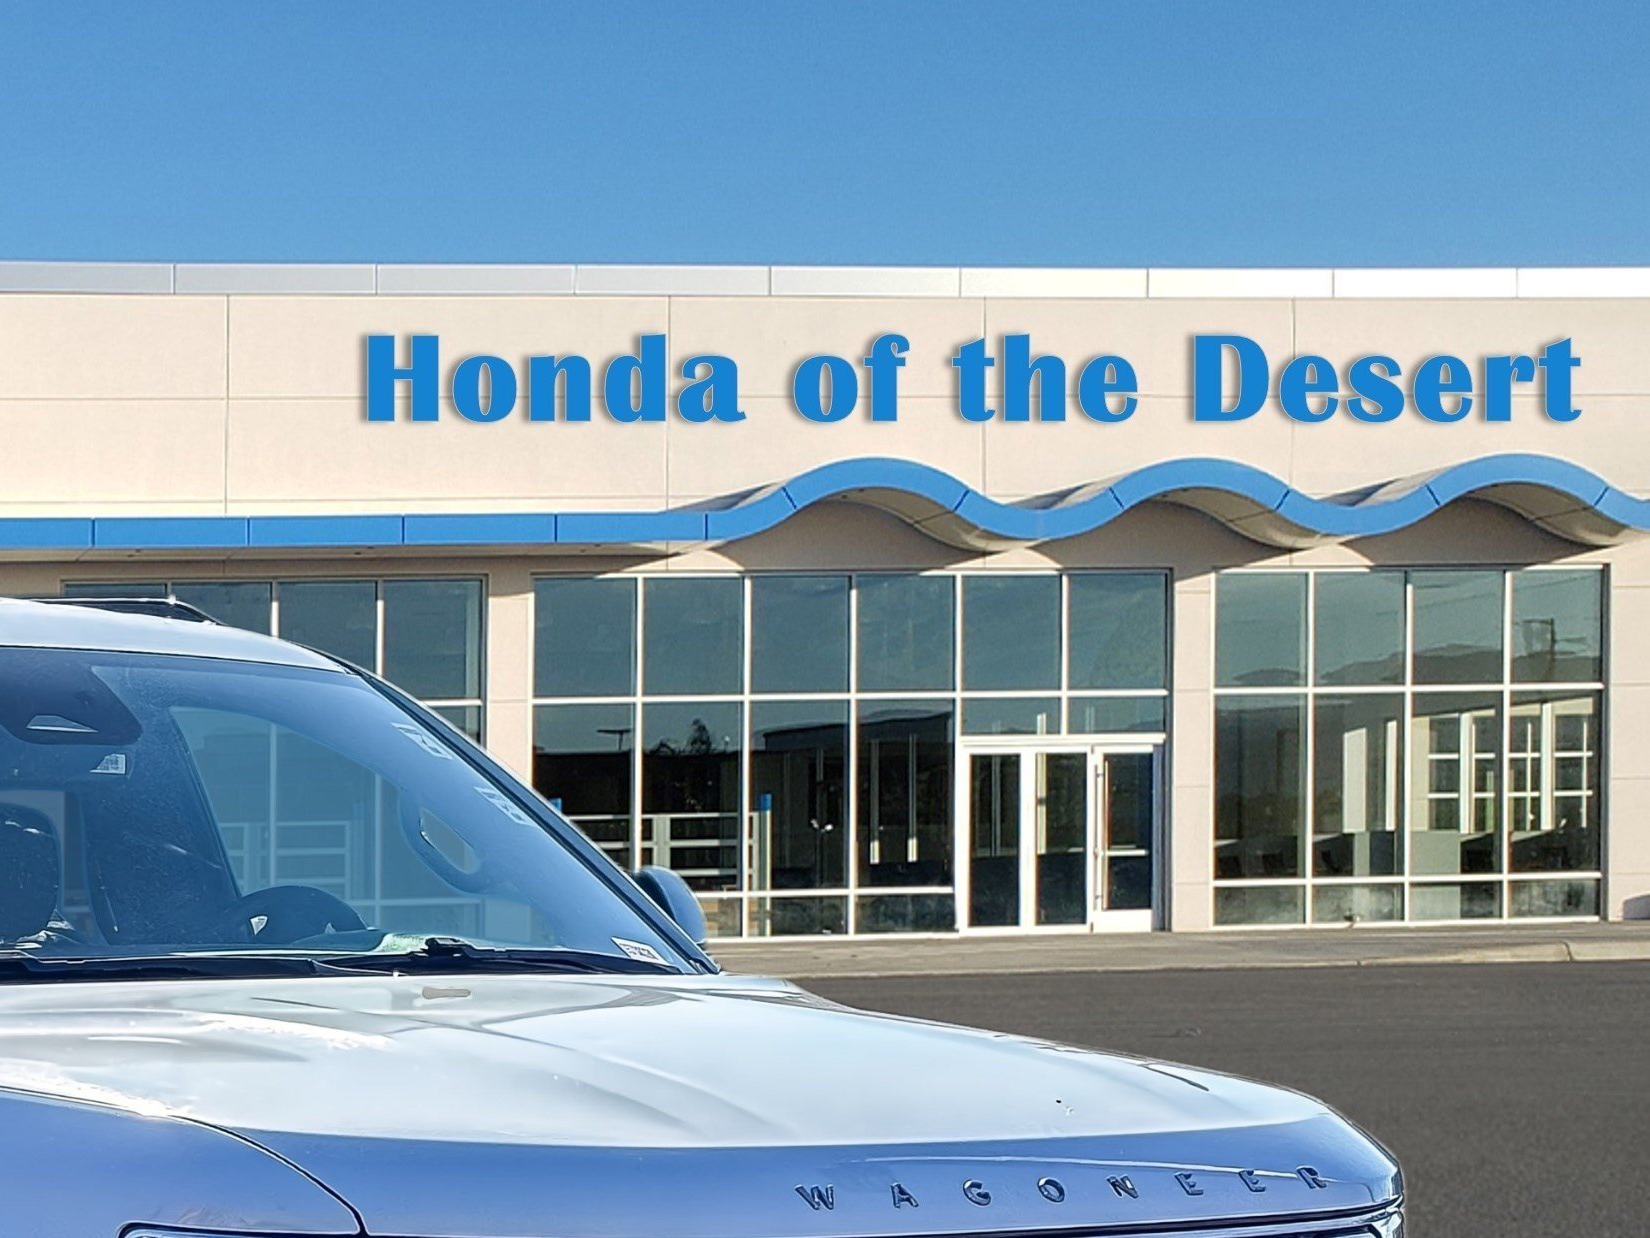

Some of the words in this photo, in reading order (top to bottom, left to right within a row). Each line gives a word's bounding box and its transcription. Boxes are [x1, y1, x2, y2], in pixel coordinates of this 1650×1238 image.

[366, 332, 747, 424] Honda
[793, 332, 911, 424] of
[951, 333, 1139, 423] the
[1194, 334, 1583, 424] Desert
[794, 1165, 1330, 1212] WAGONEER
